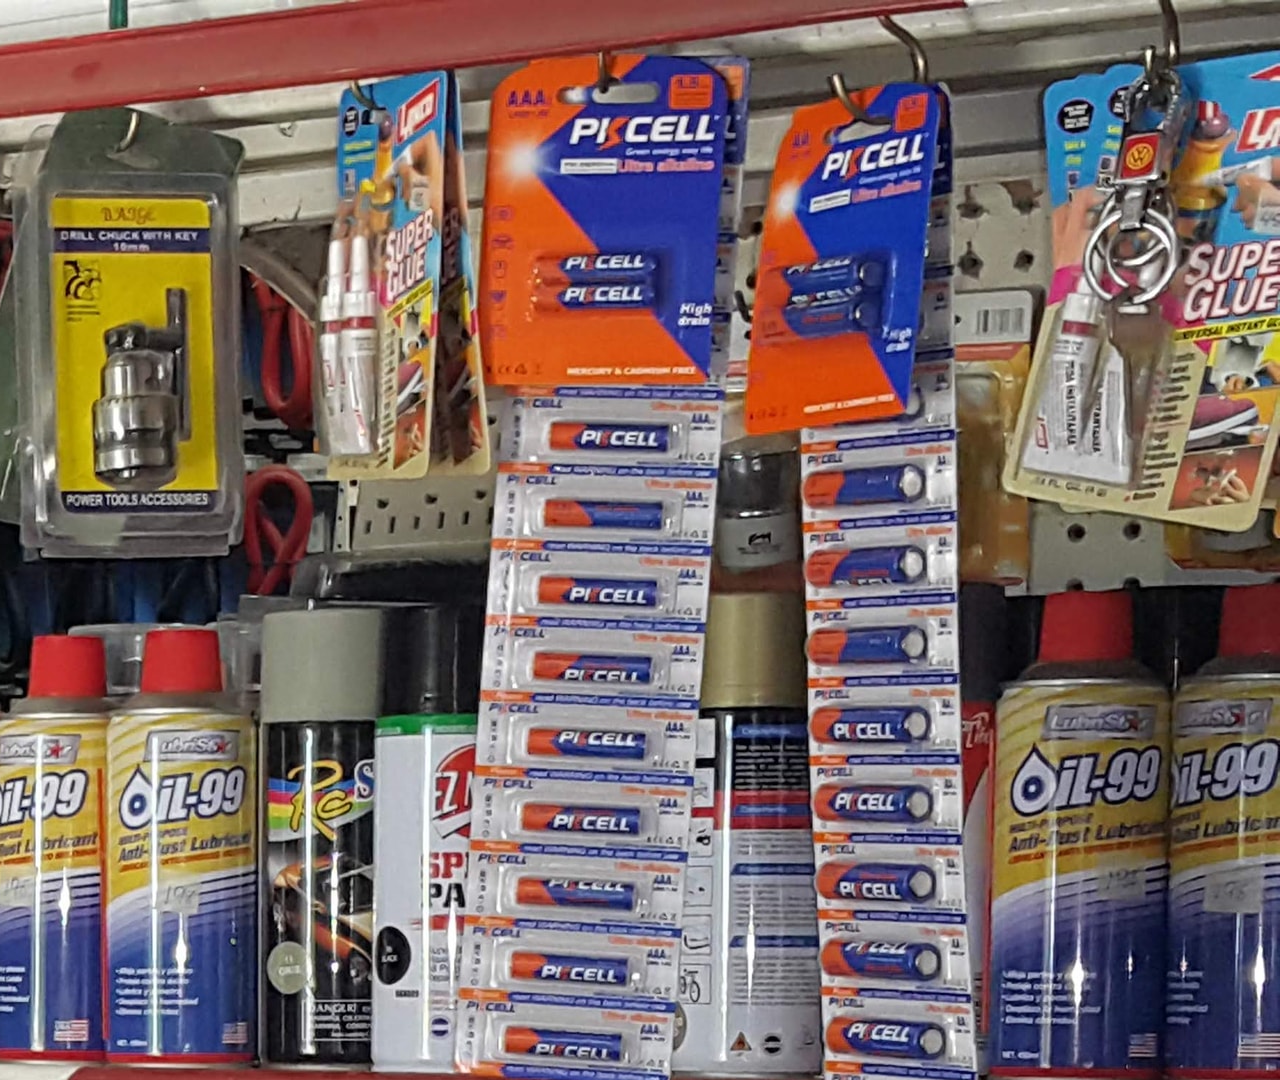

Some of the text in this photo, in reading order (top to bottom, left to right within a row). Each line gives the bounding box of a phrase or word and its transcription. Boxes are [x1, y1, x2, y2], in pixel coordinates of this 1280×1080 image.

[60, 231, 94, 241] DRILL
[98, 231, 139, 241] CHUCK
[175, 231, 198, 240] KEY
[386, 208, 433, 261] SUPER
[1184, 239, 1280, 286] SUPE
[386, 244, 426, 303] GLUE
[679, 302, 712, 316] High
[1183, 276, 1280, 323] GLUE
[678, 315, 711, 327] drain
[66, 493, 208, 507] POWER TOOLS ACCESSORIES
[25, 832, 99, 851] Lbricant
[119, 841, 185, 863] Anti-ust
